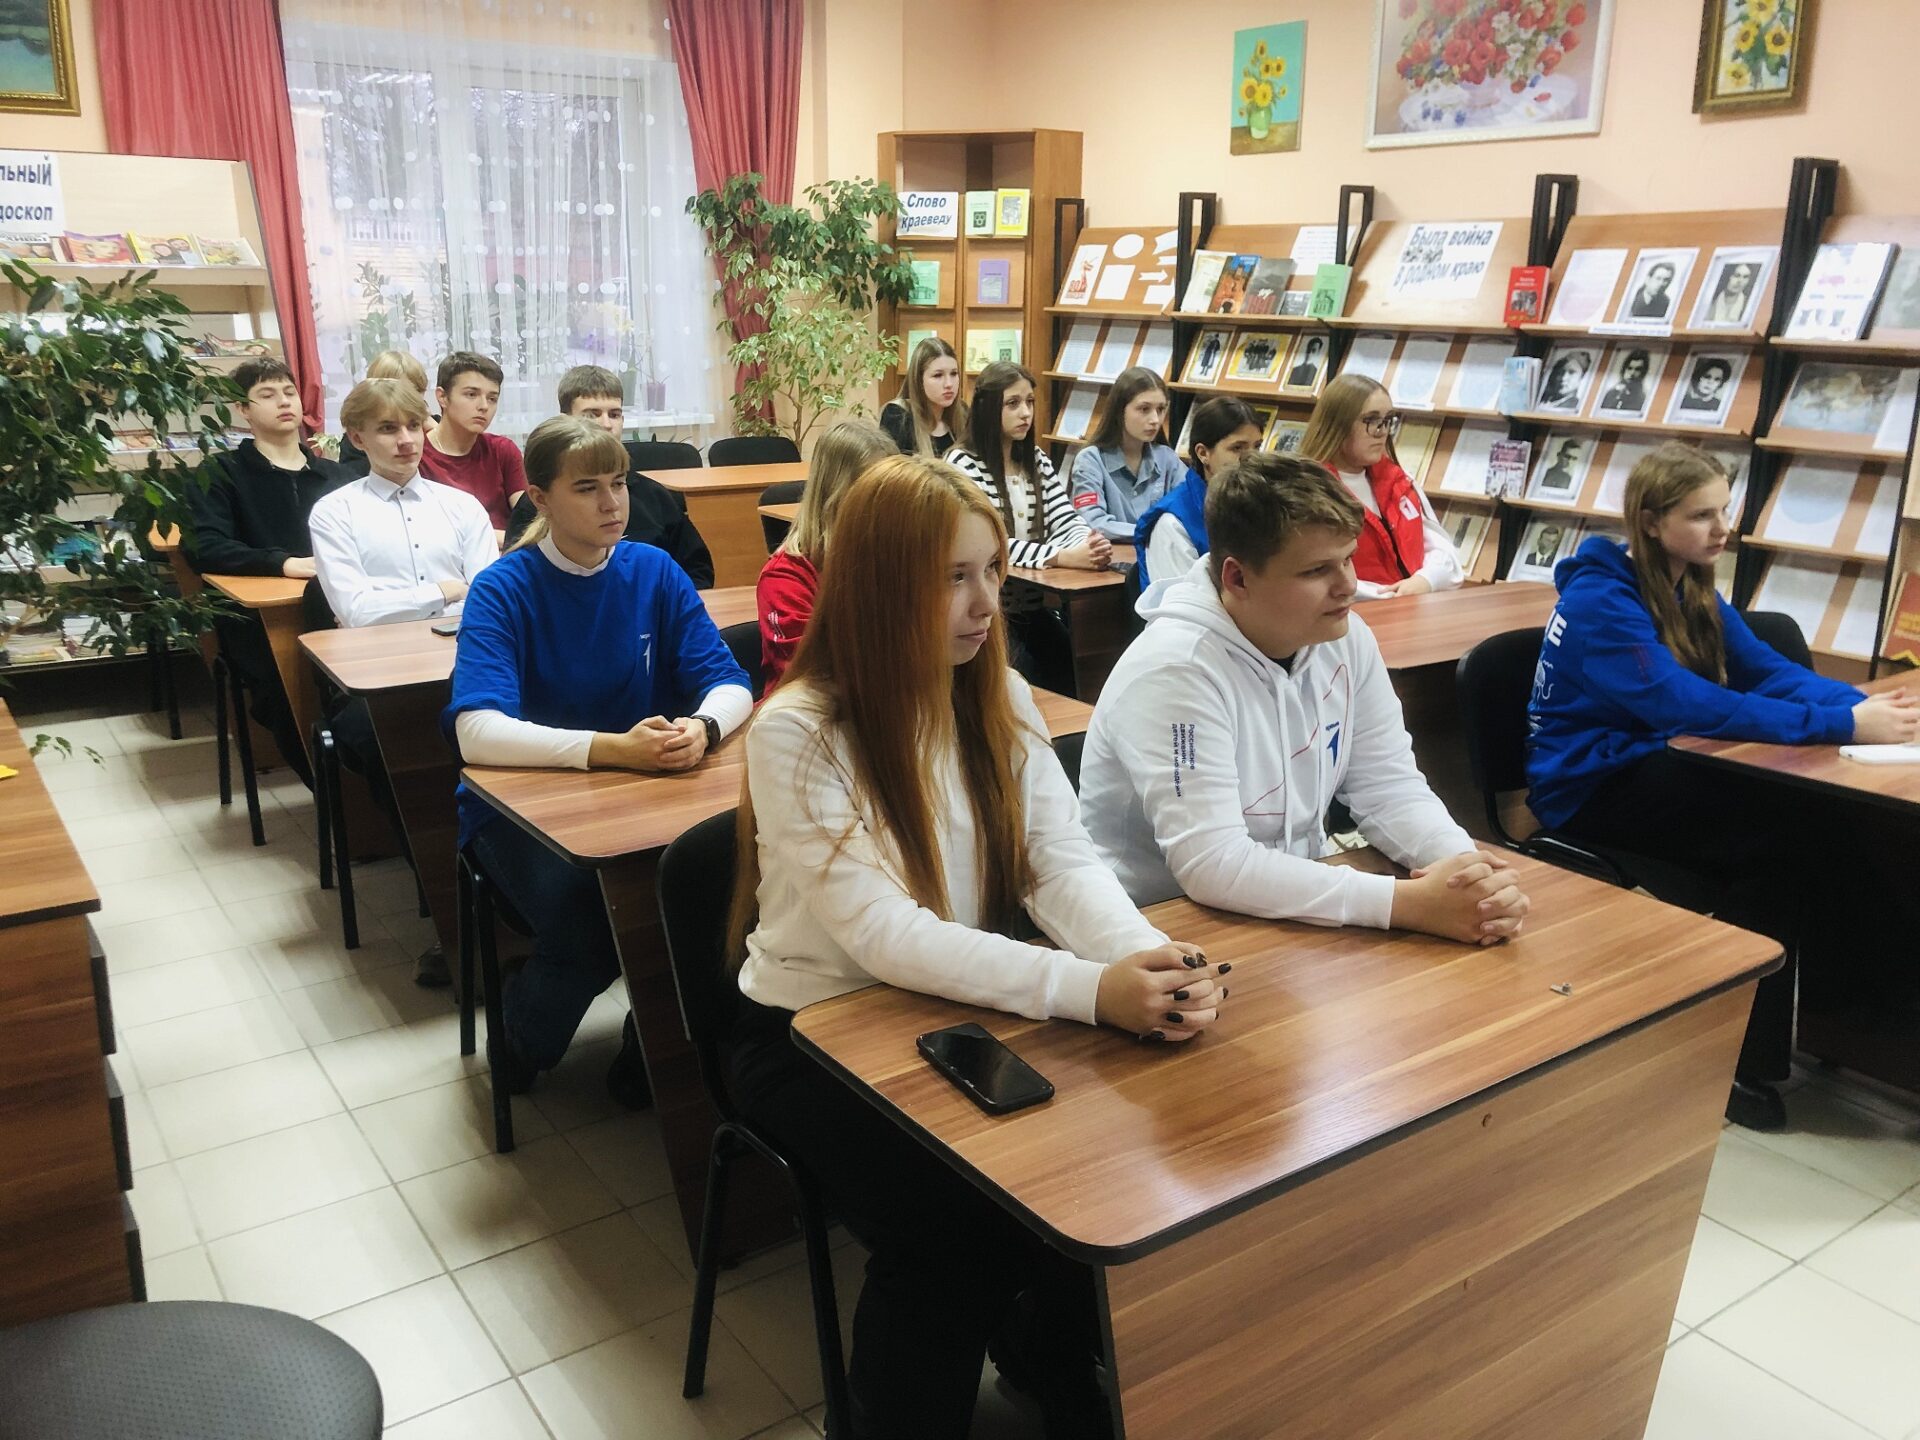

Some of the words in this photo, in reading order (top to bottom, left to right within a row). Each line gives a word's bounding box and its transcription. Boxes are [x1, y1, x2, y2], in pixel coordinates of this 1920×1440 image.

[907, 193, 947, 208] Слово
[901, 214, 951, 231] краеведу
[1409, 226, 1448, 247] Была
[1448, 225, 1493, 247] война
[1451, 260, 1485, 282] краю
